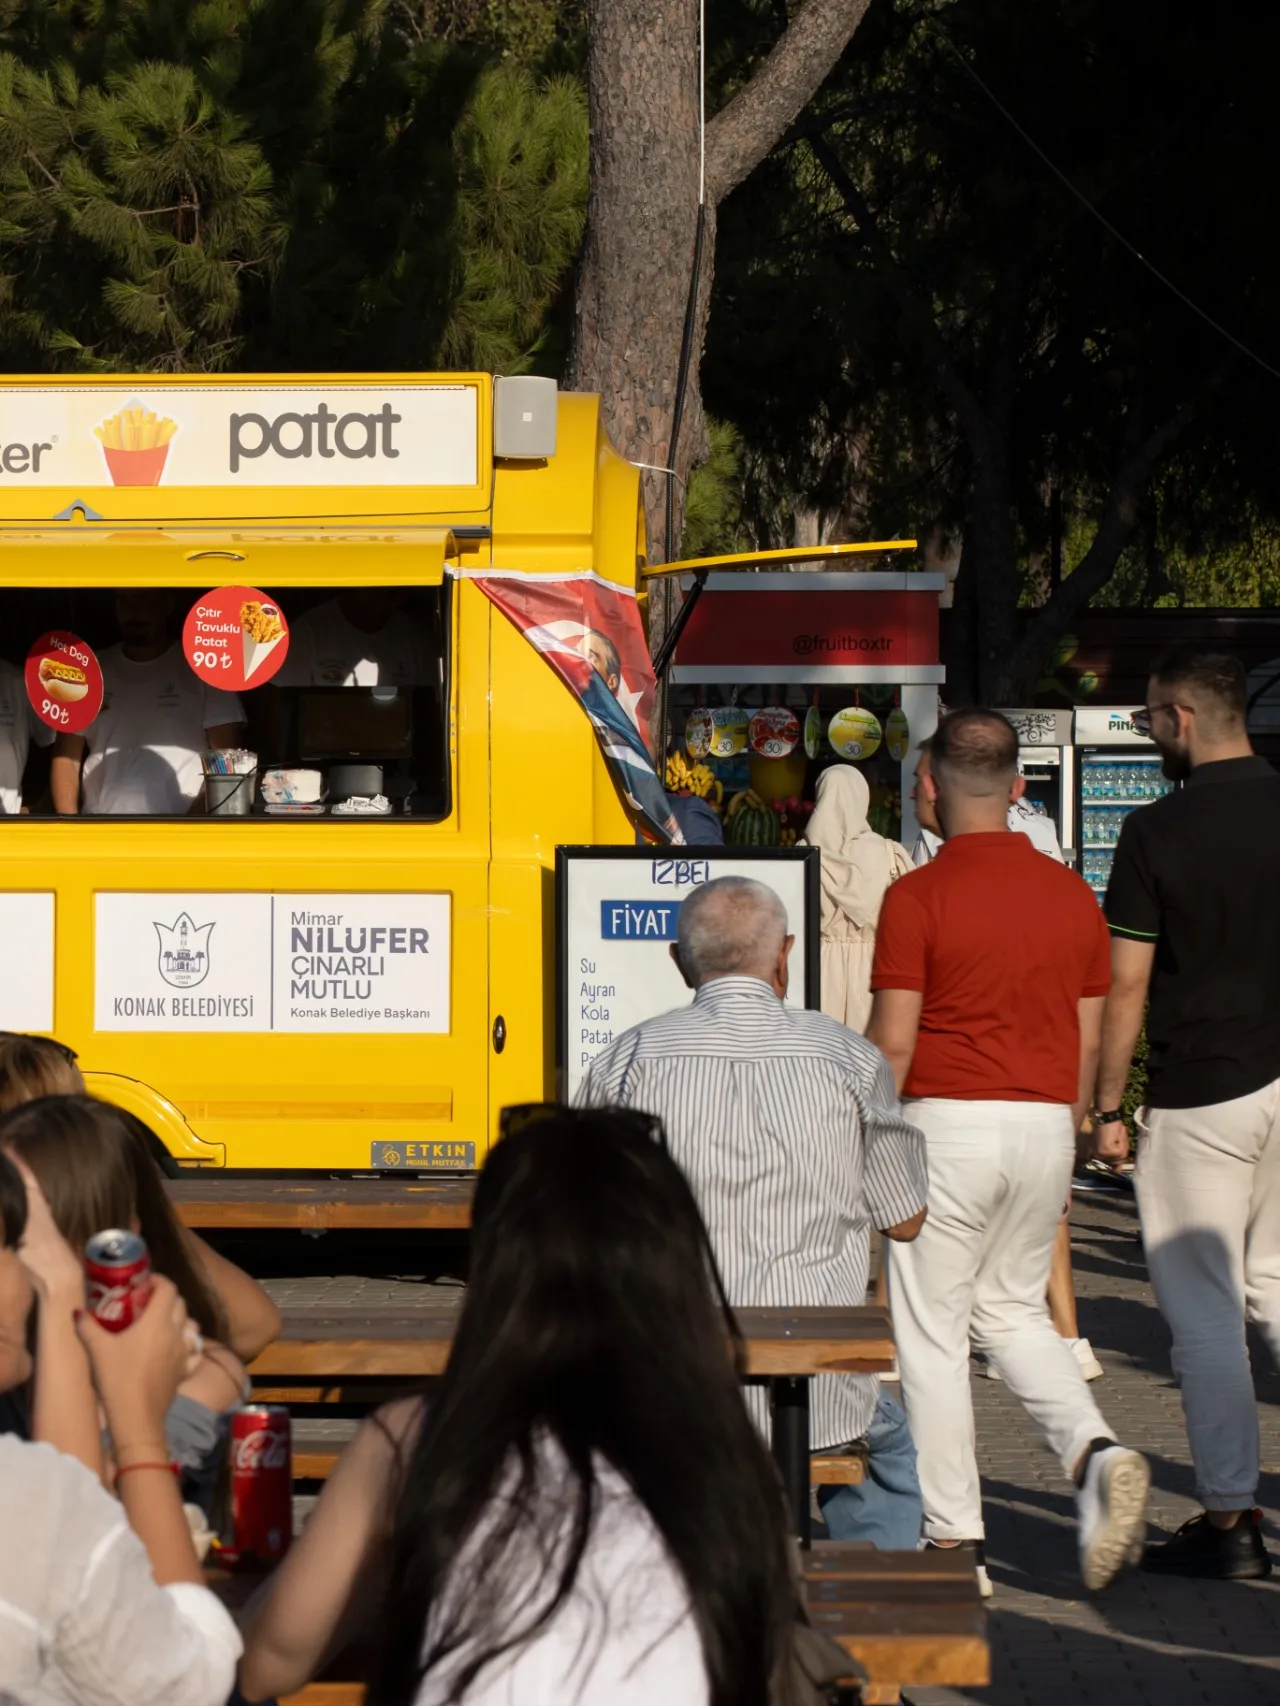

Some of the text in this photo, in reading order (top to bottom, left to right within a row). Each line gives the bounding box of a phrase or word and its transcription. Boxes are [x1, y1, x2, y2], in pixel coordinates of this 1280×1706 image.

[229, 402, 402, 474] patat
[195, 606, 223, 619] Çıtır
[195, 620, 241, 634] Tavuklu
[194, 635, 228, 648] Patat
[793, 634, 894, 655] @fruitboxtr
[49, 635, 89, 667] Hot Dog
[719, 740, 733, 753] 30
[765, 742, 781, 755] 30
[845, 742, 861, 756] 30
[291, 911, 344, 926] Mimar
[611, 903, 672, 935] FİYAT
[291, 955, 385, 980] ÇINARLI
[580, 958, 597, 975] Su
[290, 979, 372, 1000] MUTLU
[580, 981, 616, 1004] Ayran
[114, 994, 255, 1018] KONAK BELEDİYESİ
[290, 1007, 431, 1021] Konak Belediye Başkanı
[580, 1004, 610, 1021] Kola
[580, 1028, 614, 1045] Patat
